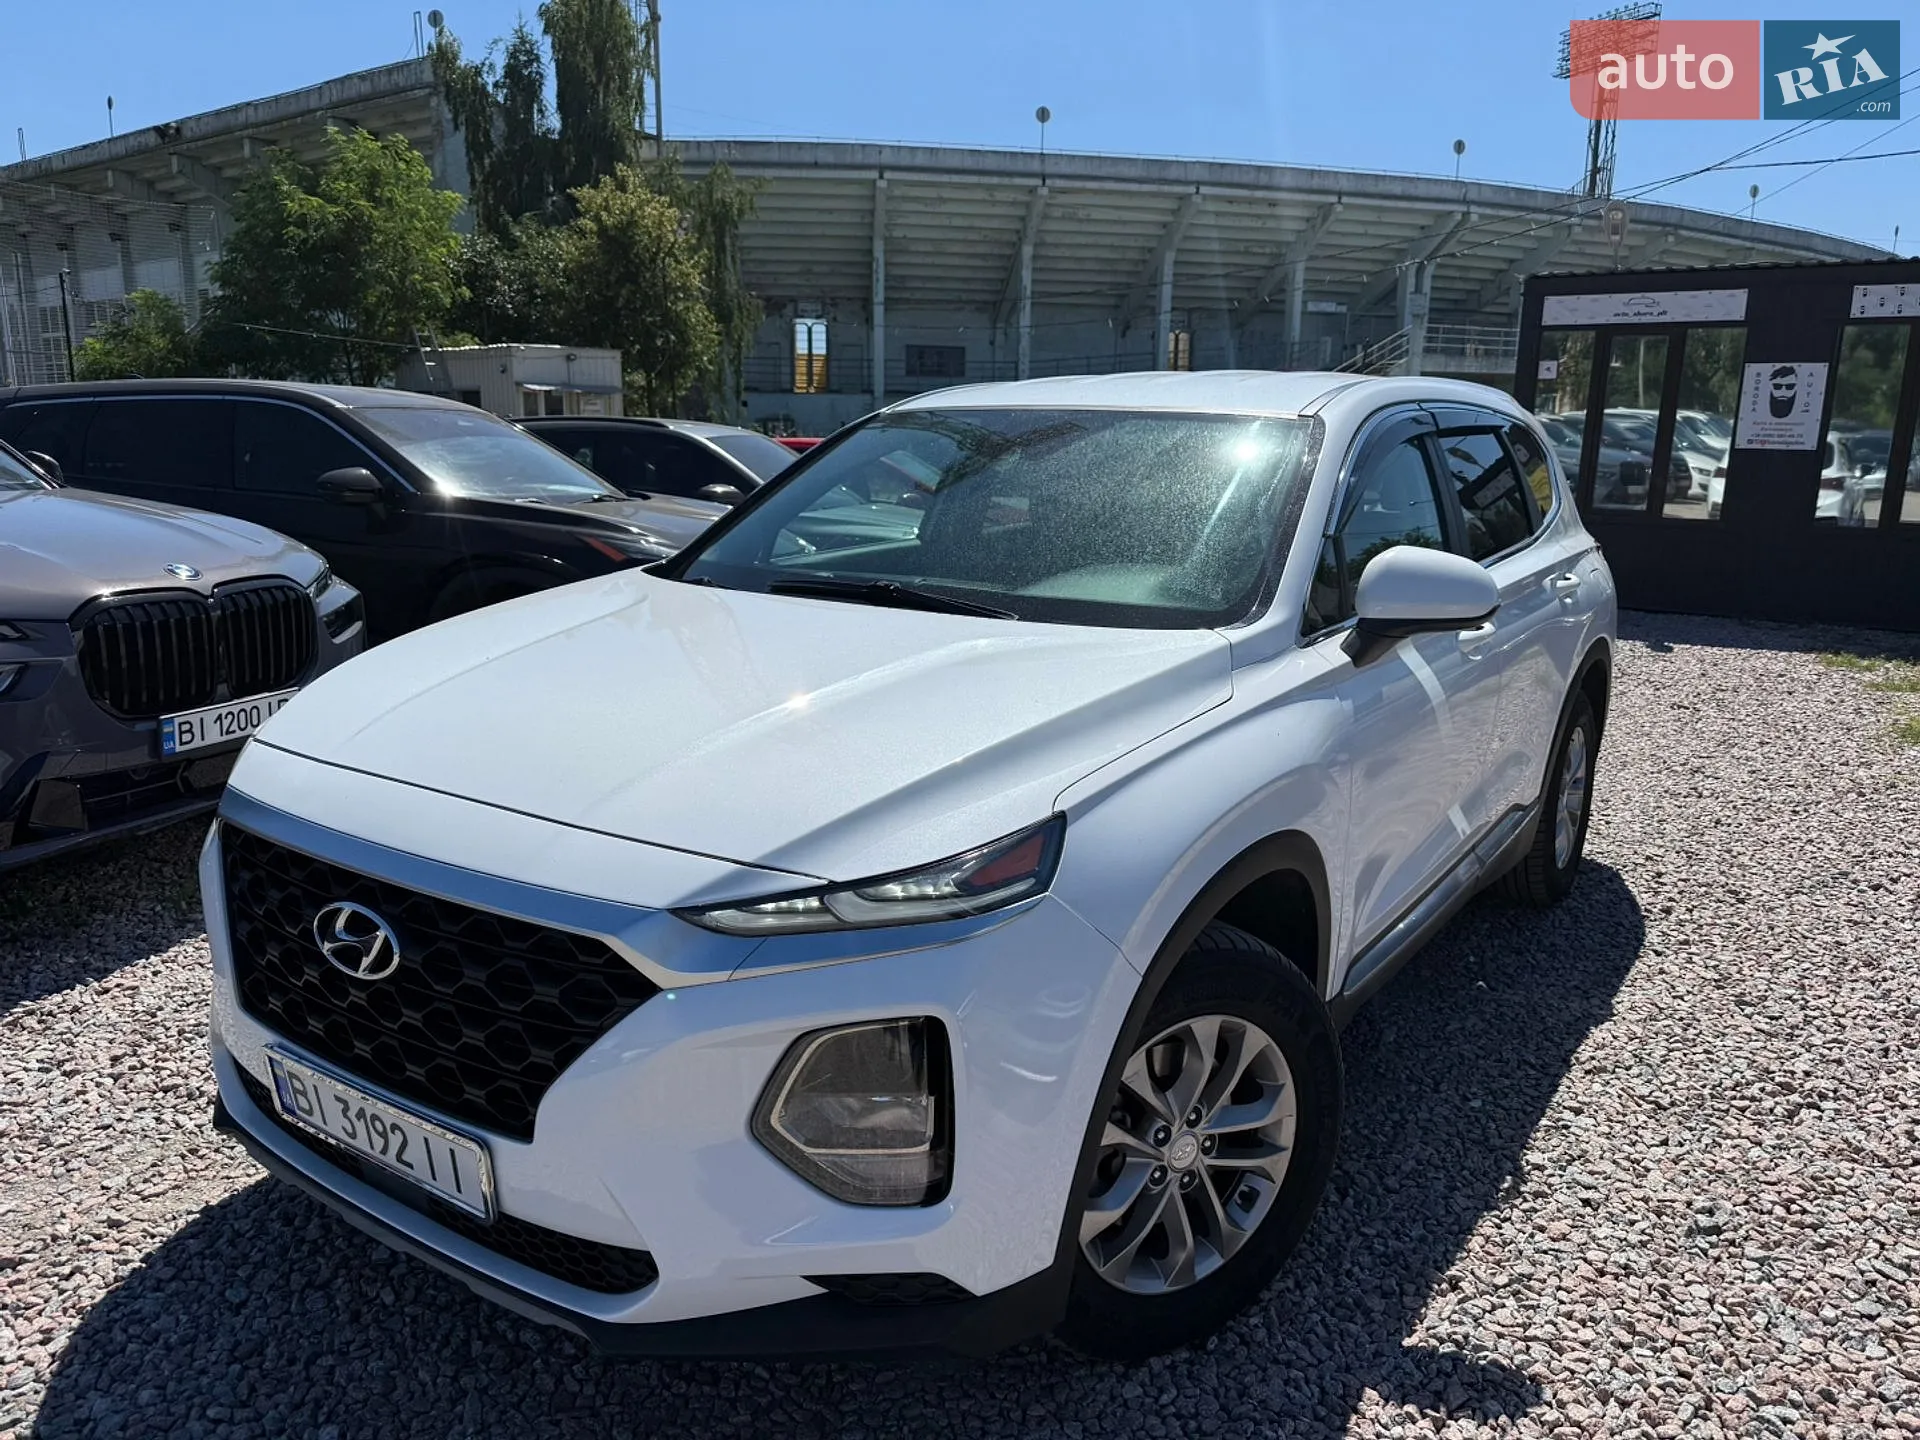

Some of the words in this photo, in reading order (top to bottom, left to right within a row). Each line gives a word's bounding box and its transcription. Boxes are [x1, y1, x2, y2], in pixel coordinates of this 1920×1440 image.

[178, 717, 205, 746] BI
[213, 705, 261, 737] 1200
[287, 1072, 327, 1126] BI
[333, 1094, 414, 1170] 3192
